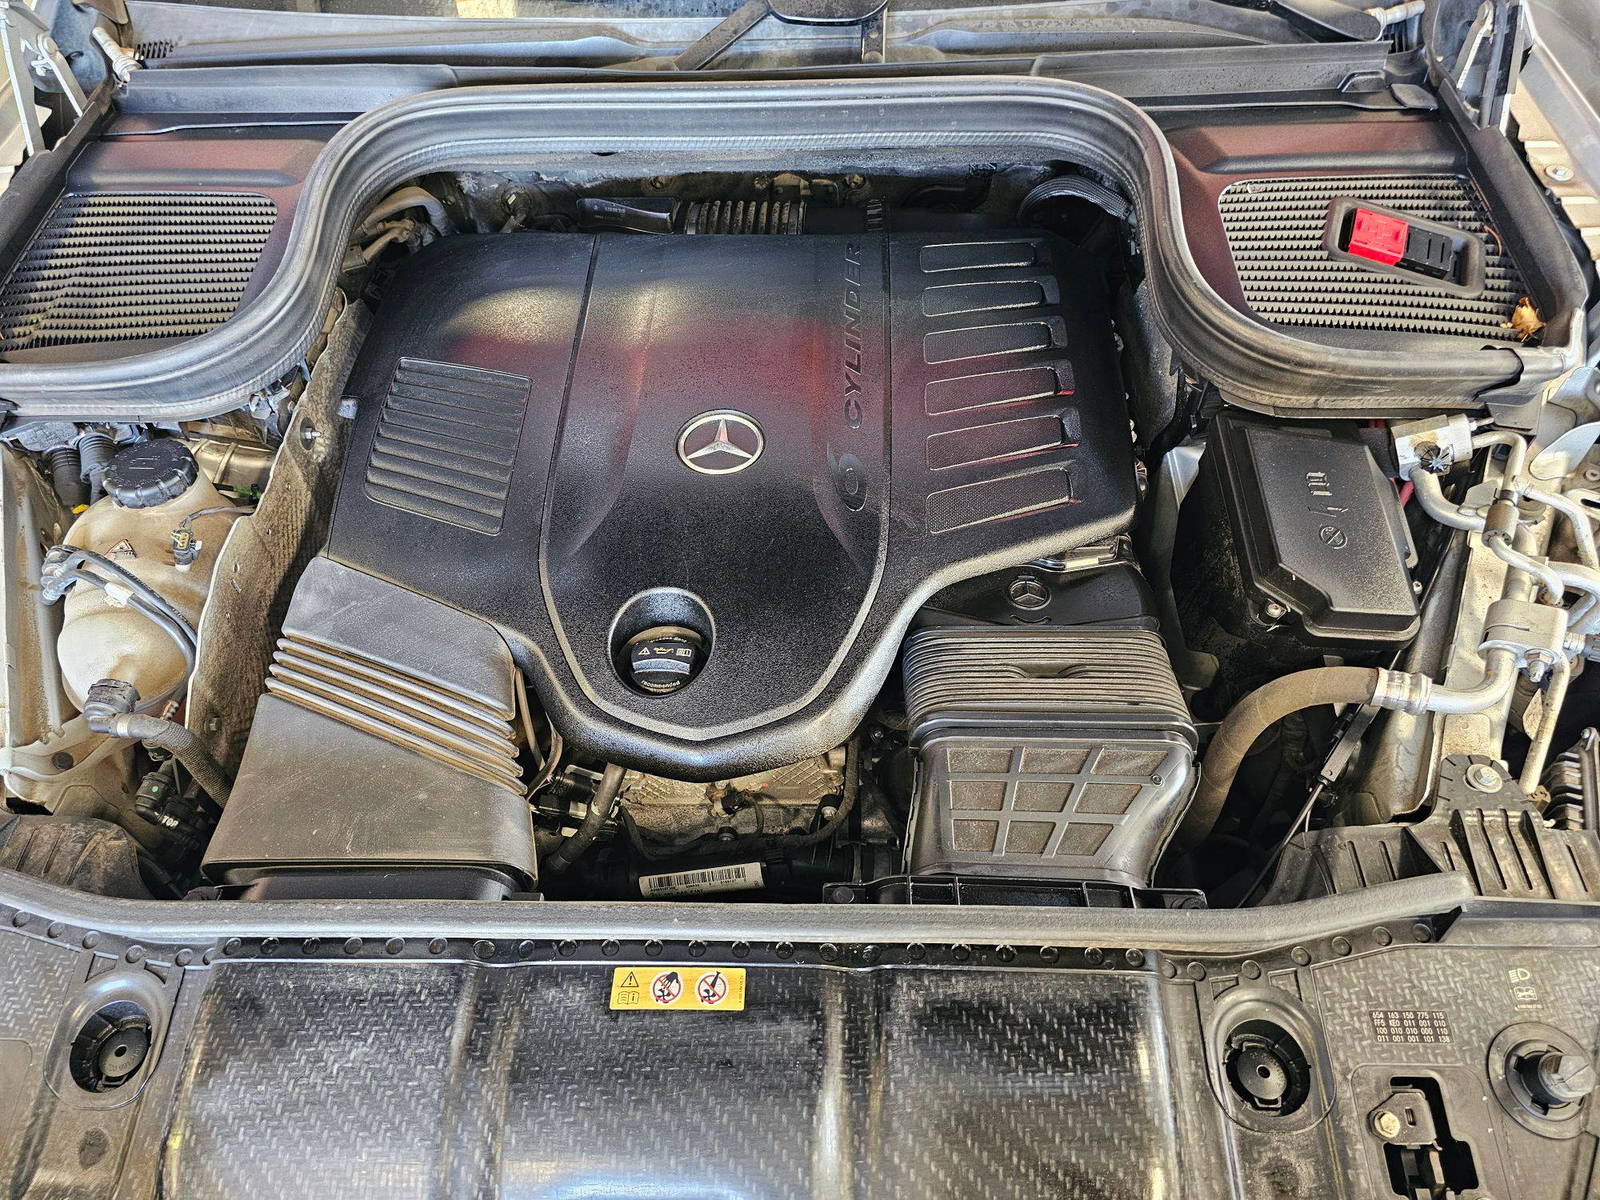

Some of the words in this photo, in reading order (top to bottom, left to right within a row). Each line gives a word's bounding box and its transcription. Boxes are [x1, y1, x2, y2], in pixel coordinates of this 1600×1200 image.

[843, 243, 863, 429] CYLINDER
[826, 440, 868, 512] 6
[161, 815, 179, 828] TOP
[1390, 1027, 1403, 1035] 010
[1405, 1027, 1418, 1035] 010
